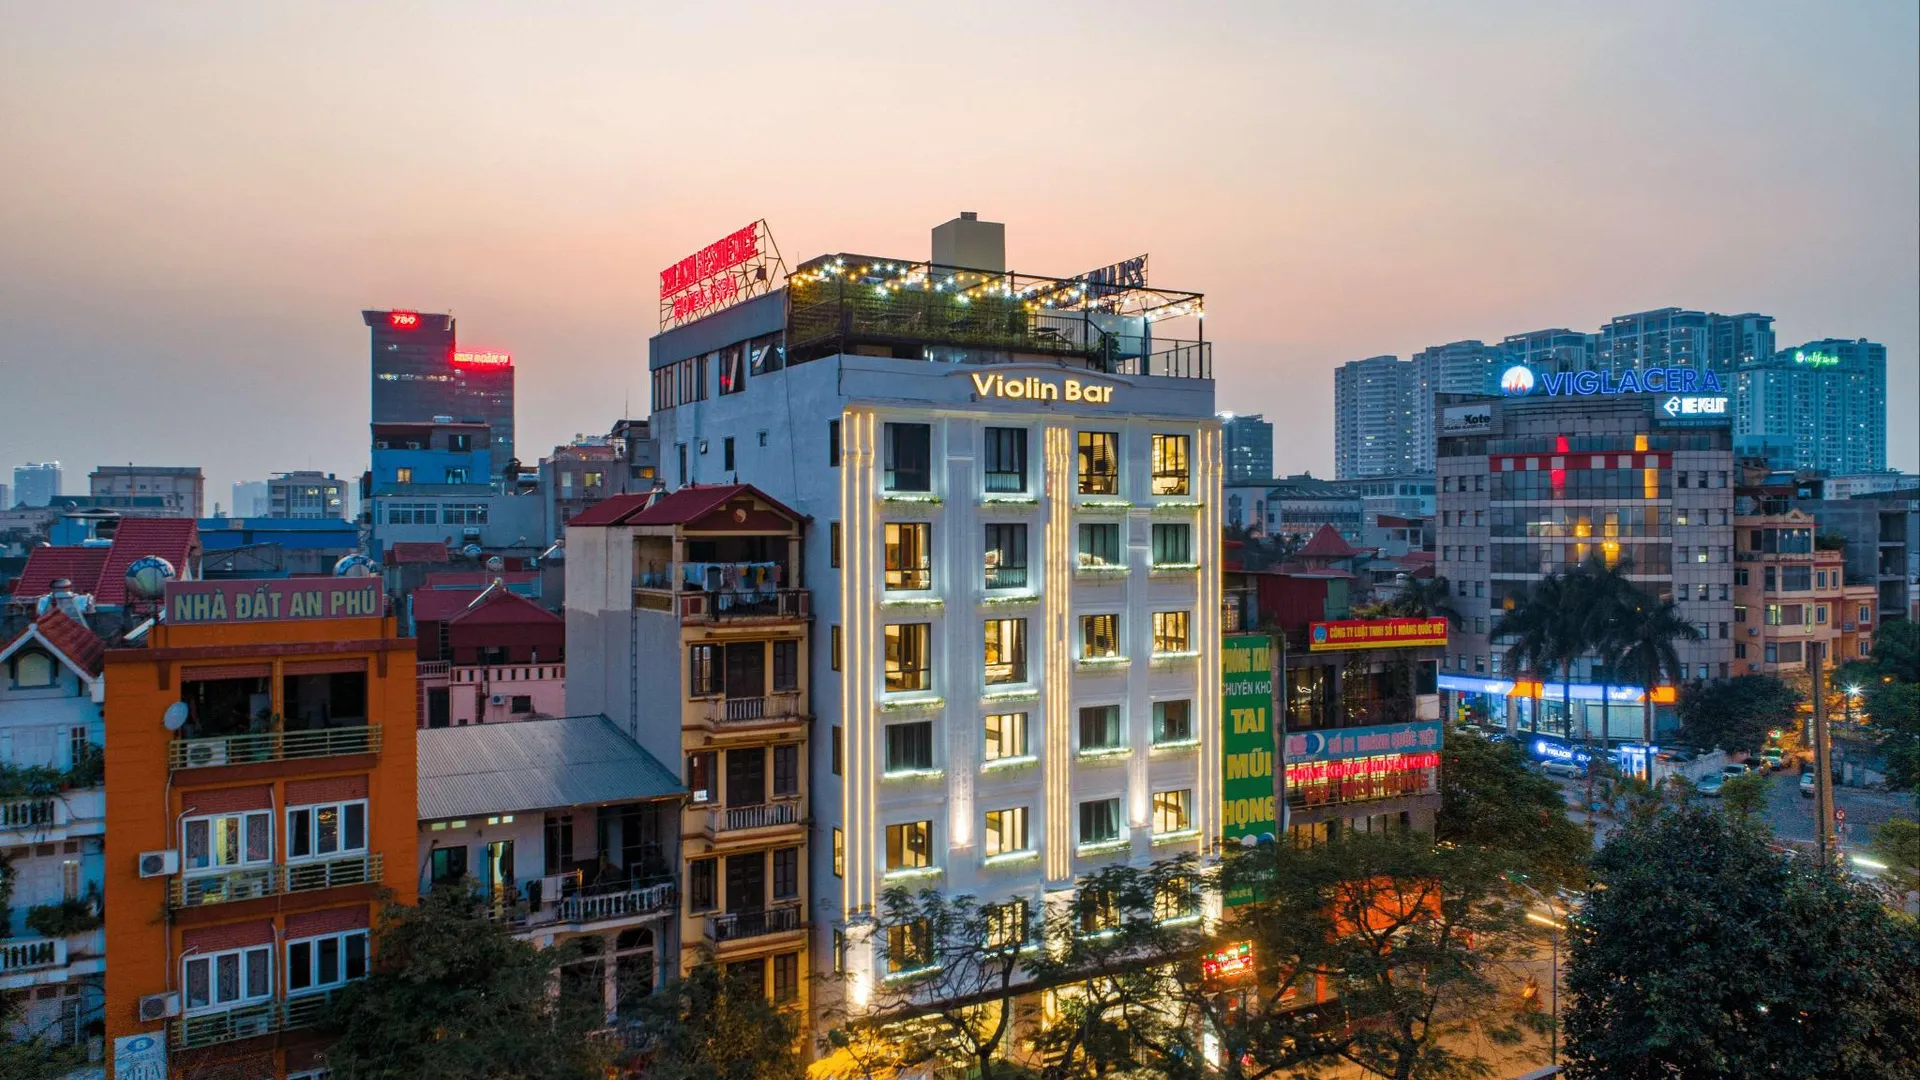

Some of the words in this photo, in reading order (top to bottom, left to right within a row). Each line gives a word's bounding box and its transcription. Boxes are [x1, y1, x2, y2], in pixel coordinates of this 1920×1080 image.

[715, 273, 738, 302] SPA
[971, 373, 1058, 400] Violin
[1065, 379, 1113, 403] Bar
[1543, 367, 1721, 396] VIGLACERA
[174, 588, 228, 621] NHÀ
[236, 583, 282, 619] ĐẤT
[289, 591, 323, 617] AN
[330, 585, 376, 616] PHÚ
[1330, 624, 1346, 639] CÔNG
[1347, 626, 1354, 638] TY
[1385, 620, 1393, 636] SỐ
[1398, 621, 1416, 635] HOÀNG
[1417, 620, 1433, 635] QUỐC
[1433, 621, 1444, 636] VIỆT
[1252, 642, 1271, 673] KHÁ
[1255, 681, 1273, 695] KHO
[1231, 708, 1266, 734] TAI
[1328, 732, 1342, 754] SỐ
[1391, 727, 1417, 749] QUỐC
[1226, 746, 1272, 780] MŨI
[1222, 796, 1277, 830] HỌNG
